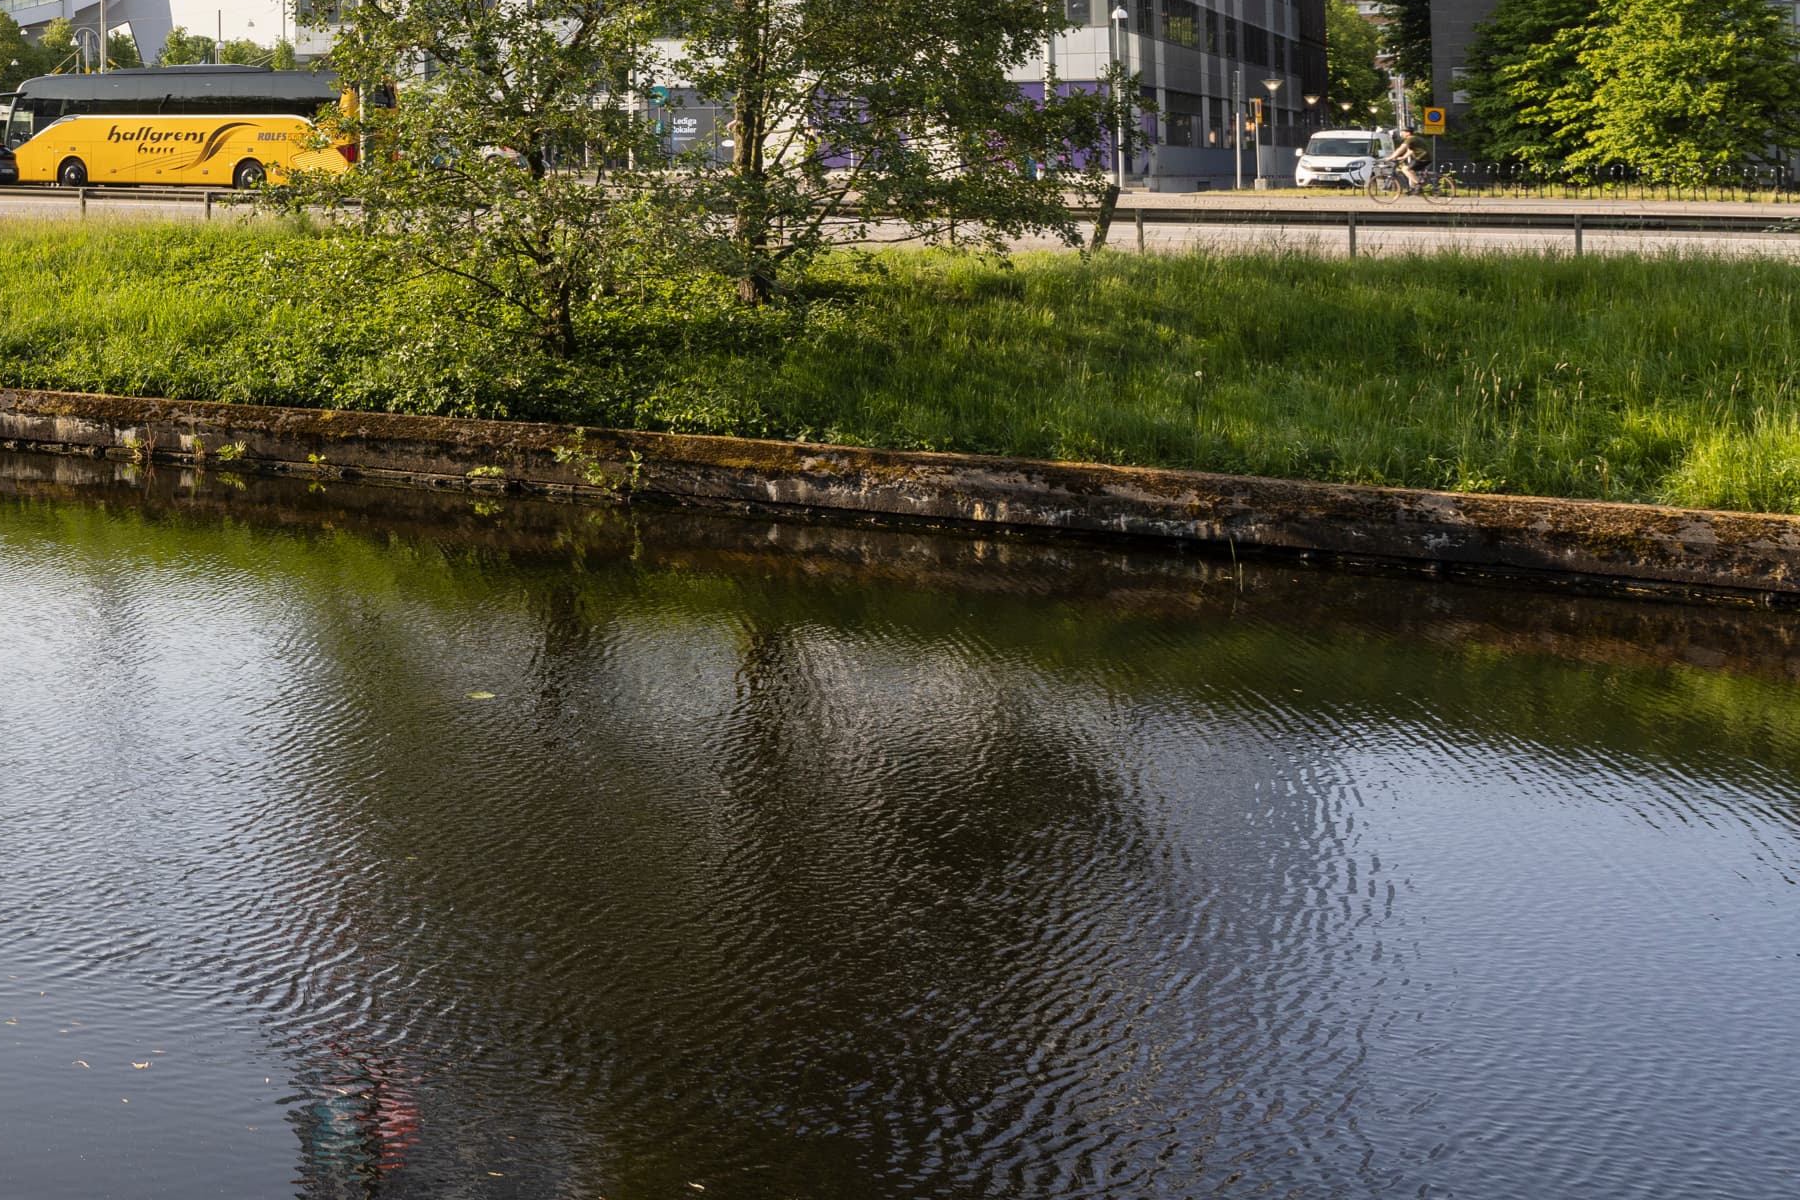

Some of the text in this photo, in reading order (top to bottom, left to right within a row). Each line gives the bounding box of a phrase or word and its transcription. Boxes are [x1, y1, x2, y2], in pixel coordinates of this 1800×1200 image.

[673, 117, 697, 126] Lediga
[107, 125, 207, 144] hallgrens
[257, 132, 287, 141] ROLFS
